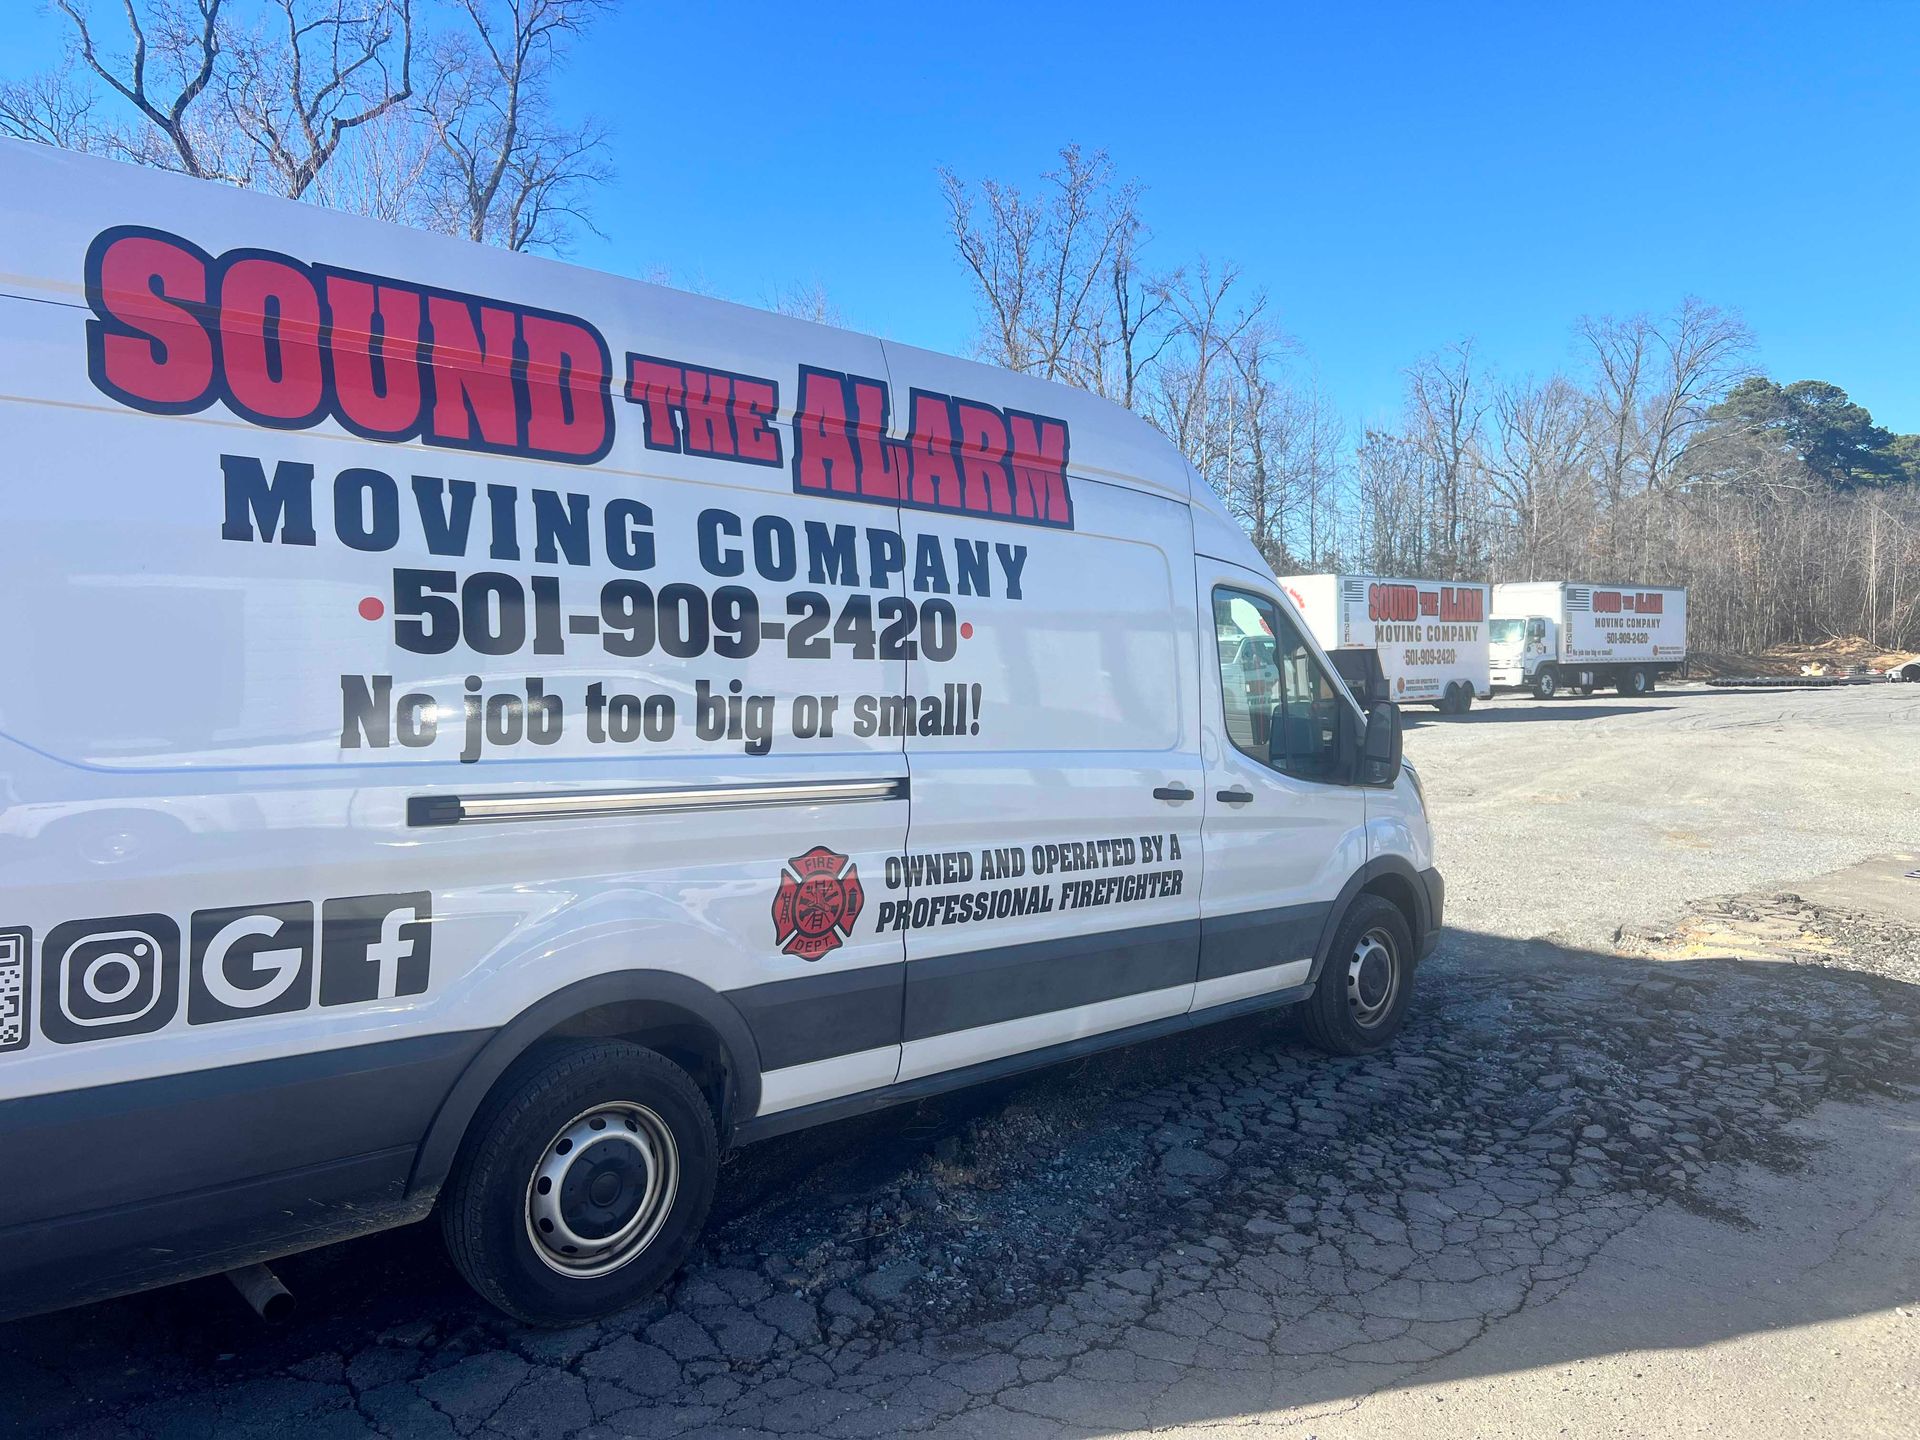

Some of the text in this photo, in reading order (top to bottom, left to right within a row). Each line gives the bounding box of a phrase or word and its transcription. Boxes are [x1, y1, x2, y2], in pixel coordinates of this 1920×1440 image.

[84, 225, 1075, 531] SOUND THE ALARM
[219, 454, 1028, 600] MOVING COMPANY
[393, 567, 957, 663] 501-909-2420
[1368, 583, 1483, 622] SOUND THE ALARM
[1595, 617, 1661, 629] MOVING COMPANY
[1374, 625, 1479, 643] MOVING COMPANY
[1404, 648, 1456, 666] 501-909-2420
[340, 675, 982, 764] No job too big or small!
[804, 857, 834, 872] FIRE
[885, 834, 1182, 889] OWNED AND OPERATED BY A
[875, 869, 1184, 933] PROFESSIONAL FIREFIGHTER
[202, 915, 302, 1008] G
